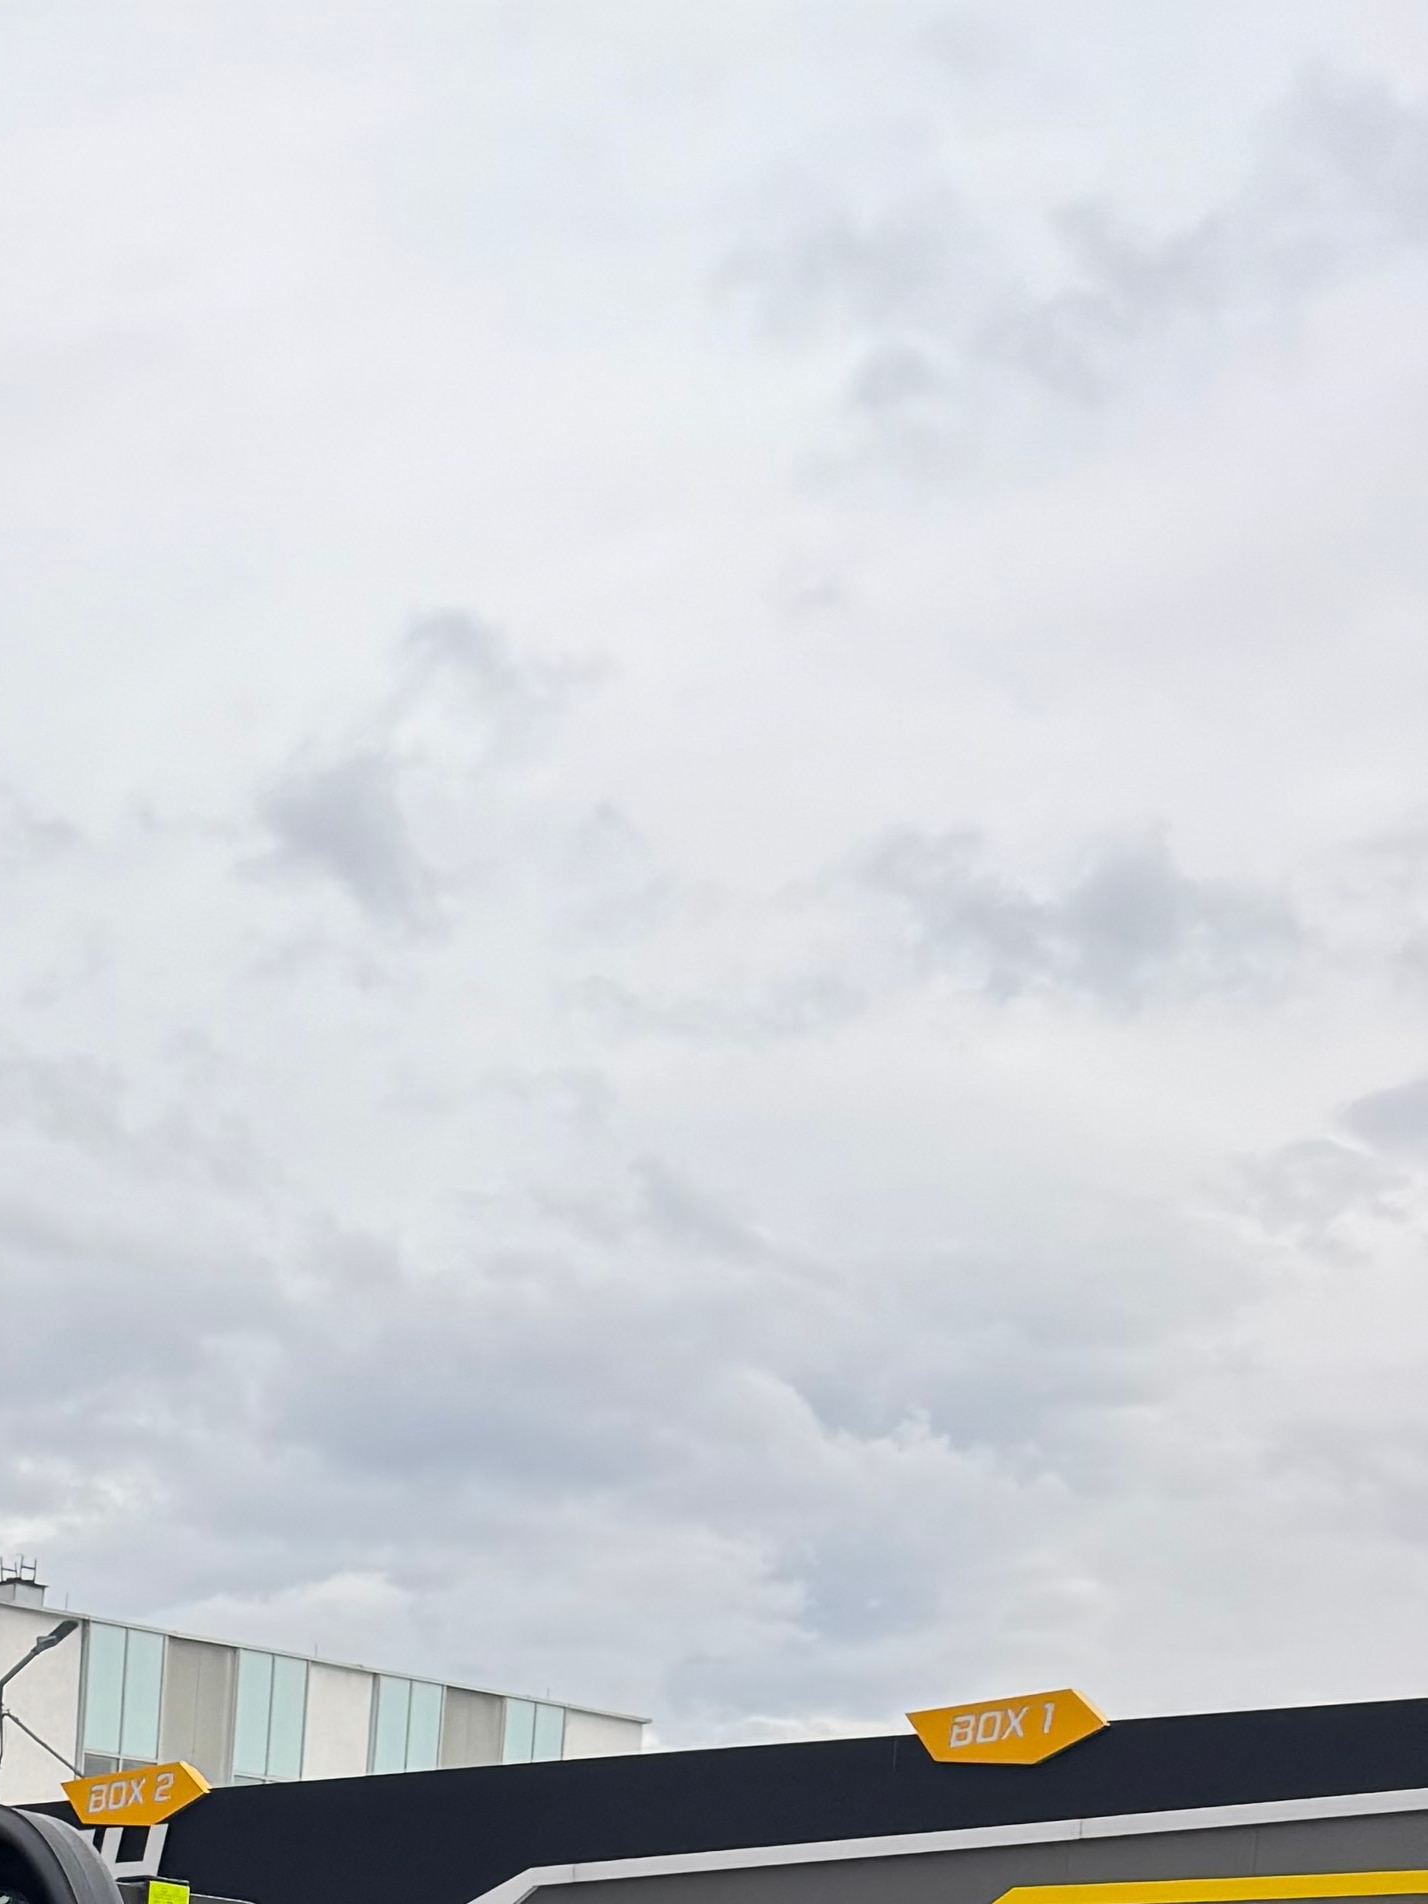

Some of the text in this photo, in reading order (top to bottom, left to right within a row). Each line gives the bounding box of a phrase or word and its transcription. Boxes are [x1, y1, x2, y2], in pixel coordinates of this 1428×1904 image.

[949, 1702, 1056, 1748] BOX 1
[87, 1771, 176, 1814] BOX 2
